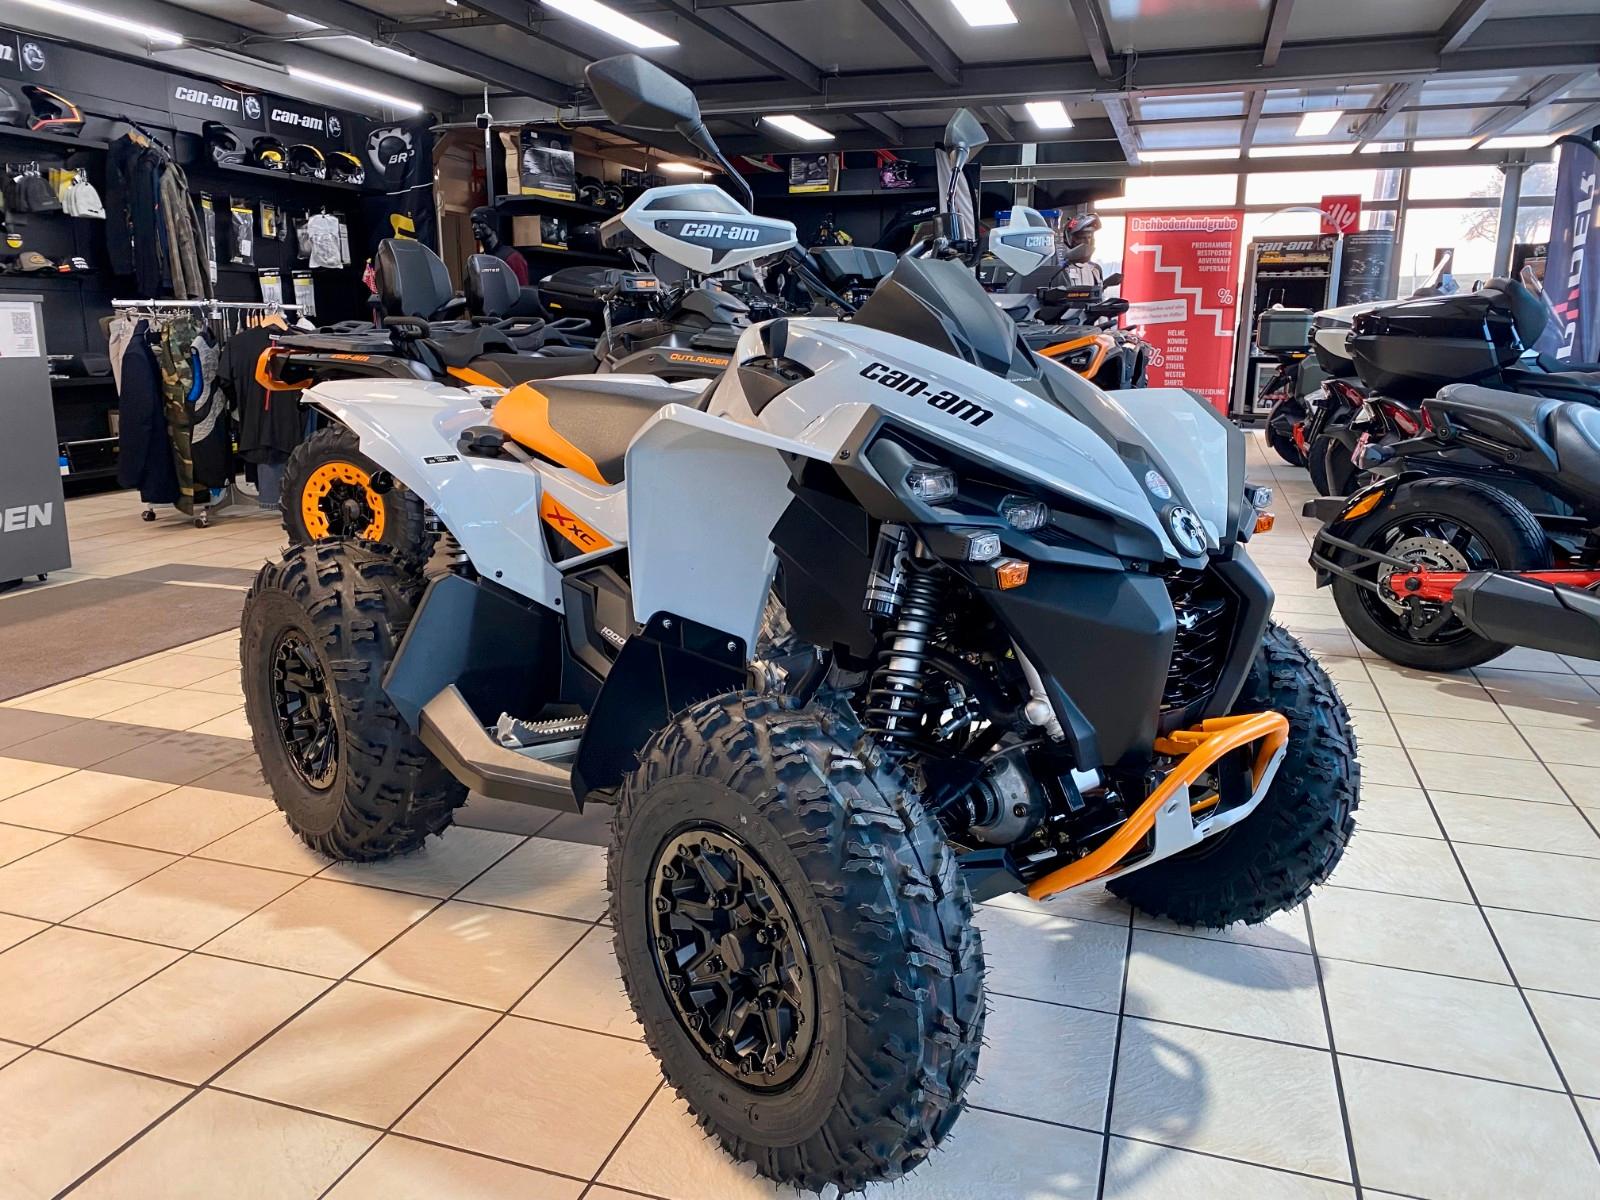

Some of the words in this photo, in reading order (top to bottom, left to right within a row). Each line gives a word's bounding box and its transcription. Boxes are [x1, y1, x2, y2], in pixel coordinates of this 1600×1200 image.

[175, 86, 239, 112] can-am
[271, 108, 324, 131] can-am
[1132, 217, 1237, 231] Dachbodenfundgrube
[1323, 203, 1357, 231] illy
[679, 221, 760, 243] can-am
[670, 353, 729, 367] OUTLANDER
[859, 362, 994, 428] can-am
[0, 502, 53, 533] EN
